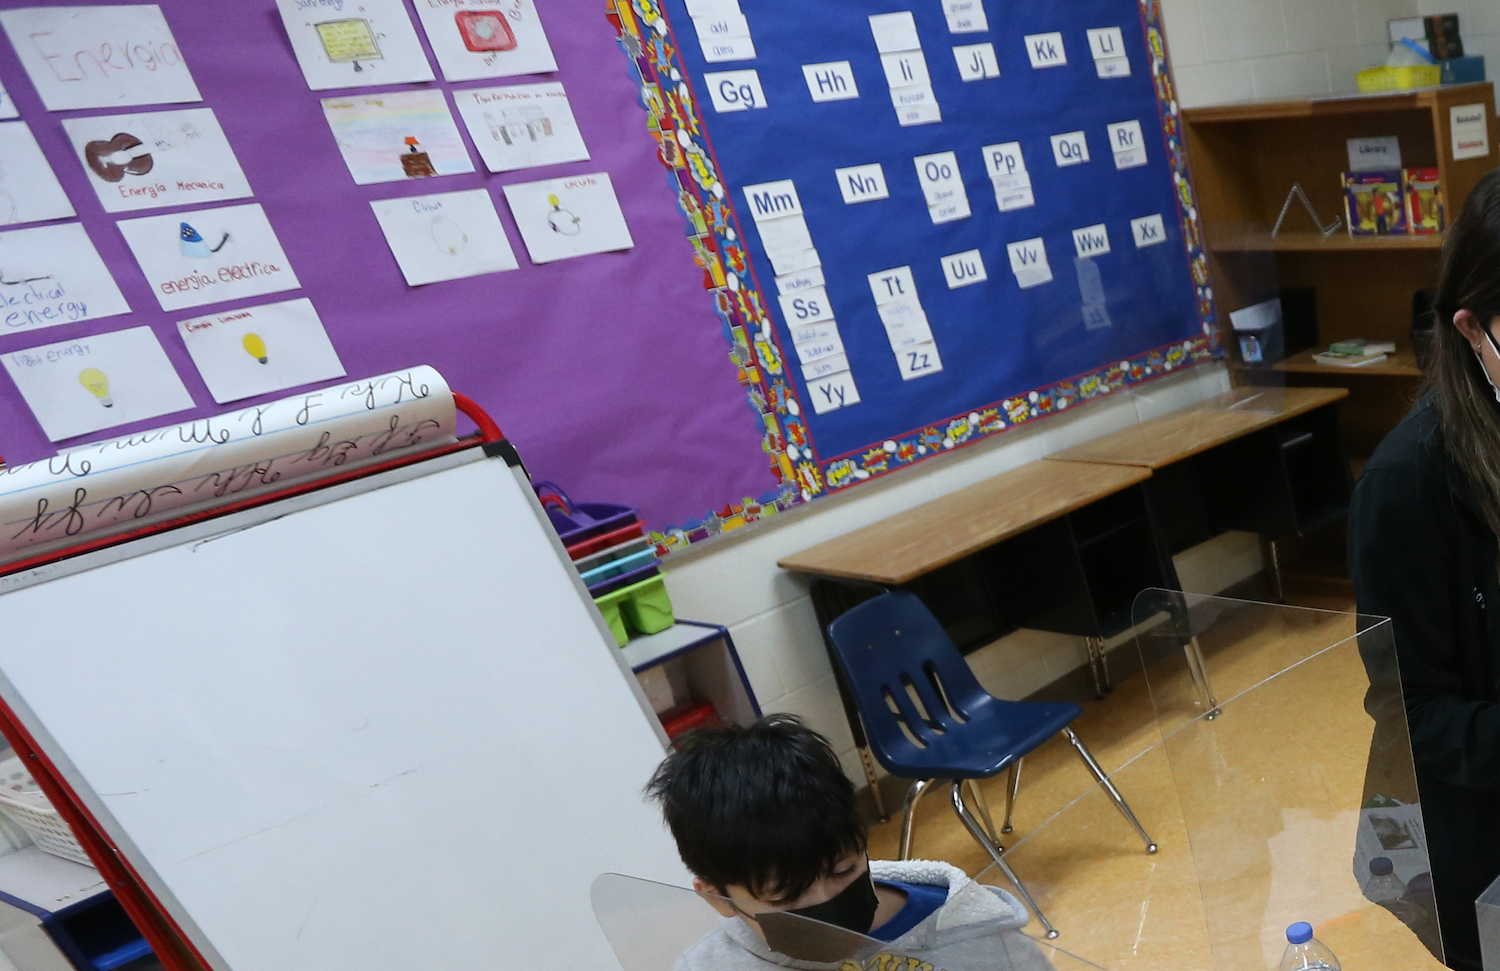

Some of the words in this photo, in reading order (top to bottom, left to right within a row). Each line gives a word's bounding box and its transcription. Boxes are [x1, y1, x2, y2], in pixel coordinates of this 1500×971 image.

[1034, 41, 1059, 61] Kk
[1098, 33, 1114, 54] Ll
[970, 50, 987, 79] Jj
[814, 69, 848, 94] Hh
[719, 79, 756, 109] Gg
[1117, 127, 1135, 147] Rr
[1058, 139, 1084, 163] Qq
[1359, 145, 1387, 155] Library
[925, 161, 951, 182] Oo
[992, 151, 1016, 175] Pp
[848, 173, 878, 196] Nn
[752, 191, 796, 216] Mm
[1076, 232, 1105, 251] Ww
[1139, 222, 1158, 241] Xx
[1015, 246, 1038, 266] Vv
[950, 259, 978, 280] Uu
[880, 274, 905, 297] Tt
[5, 301, 88, 328] energy
[792, 297, 821, 319] Ss
[906, 350, 932, 372] Zz
[818, 382, 846, 408] Yy
